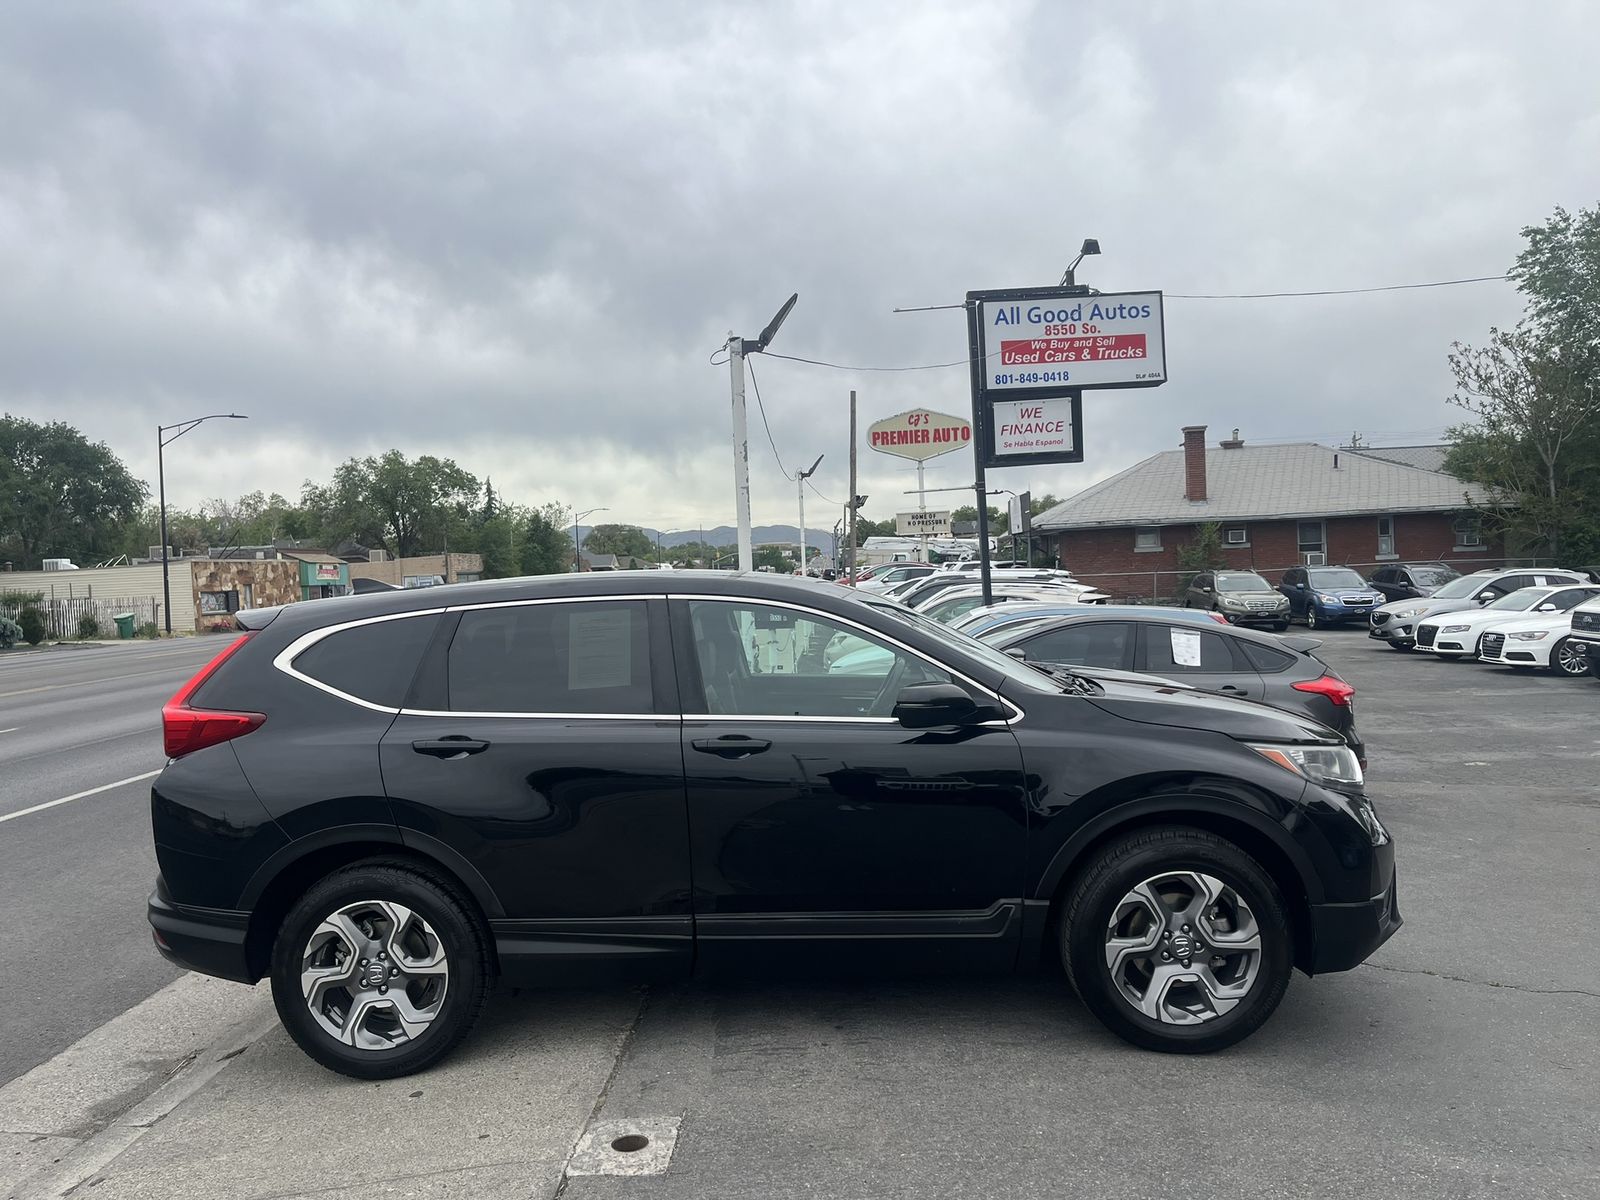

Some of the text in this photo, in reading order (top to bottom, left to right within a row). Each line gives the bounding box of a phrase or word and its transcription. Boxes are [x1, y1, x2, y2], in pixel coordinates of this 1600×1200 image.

[994, 303, 1151, 326] All Good Autos
[1044, 323, 1101, 336] 8550 So.
[1031, 337, 1116, 350] We Buy and Sell
[1004, 347, 1143, 364] Used Cars & Trucks
[994, 371, 1070, 385] 801-849-0418
[1020, 406, 1043, 420] WE
[1000, 421, 1065, 436] FINANCE
[872, 426, 971, 446] PREMIER AUTO
[1035, 438, 1064, 446] Espanol
